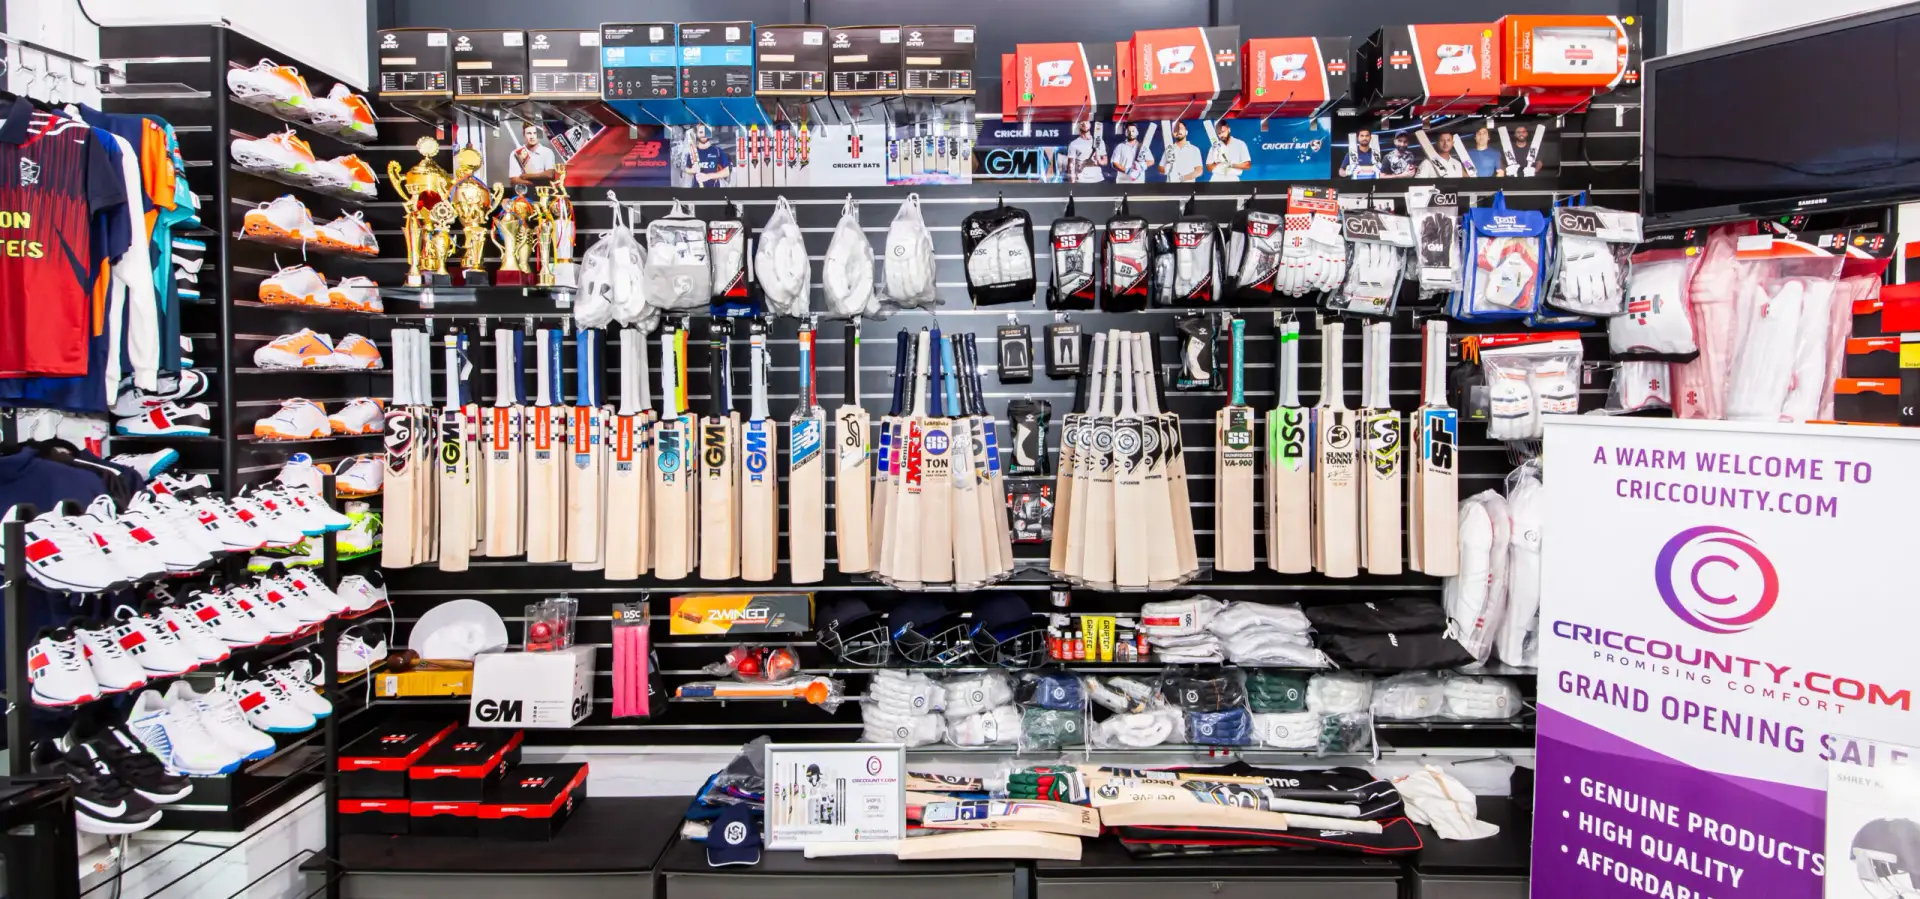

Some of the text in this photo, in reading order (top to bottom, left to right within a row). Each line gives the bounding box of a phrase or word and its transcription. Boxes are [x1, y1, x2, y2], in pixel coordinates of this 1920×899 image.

[1036, 129, 1059, 137] BATS
[1262, 142, 1294, 150] CRICKET
[985, 149, 1038, 178] GM
[1434, 194, 1456, 204] GM
[1253, 223, 1268, 234] SS
[1346, 217, 1379, 235] GM
[1559, 213, 1597, 233] GM
[712, 230, 726, 240] SS
[1061, 236, 1076, 248] SS
[1115, 230, 1130, 239] SS
[1180, 234, 1195, 245] SS
[1120, 266, 1132, 274] SS
[442, 423, 460, 465] GM
[1228, 432, 1249, 444] SS
[1282, 412, 1305, 458] DSC
[1431, 418, 1452, 469] SF
[658, 431, 680, 473] GM
[705, 426, 726, 467] GM
[746, 432, 767, 473] GM
[926, 459, 948, 468] TON
[1593, 446, 1872, 484] A WARM WELCOME TO
[1616, 479, 1838, 517] CRICCOUNTY.COM
[624, 611, 640, 619] DSC
[708, 608, 770, 620] ZWINGO
[1552, 620, 1911, 711] CRICCOUNTY.COM
[1593, 651, 1845, 714] PROMISING COMFORT
[475, 699, 522, 722] GM
[572, 693, 588, 721] GM
[1558, 670, 1649, 713] GRAND
[1661, 696, 1804, 753] OPENING
[1837, 773, 1871, 786] SHREY
[1082, 810, 1090, 824] TON
[1580, 777, 1825, 877] GENUINE PRODUCTS
[1579, 811, 1744, 889] HIGH QUALITY
[1577, 848, 1713, 899] AFFORDAB
